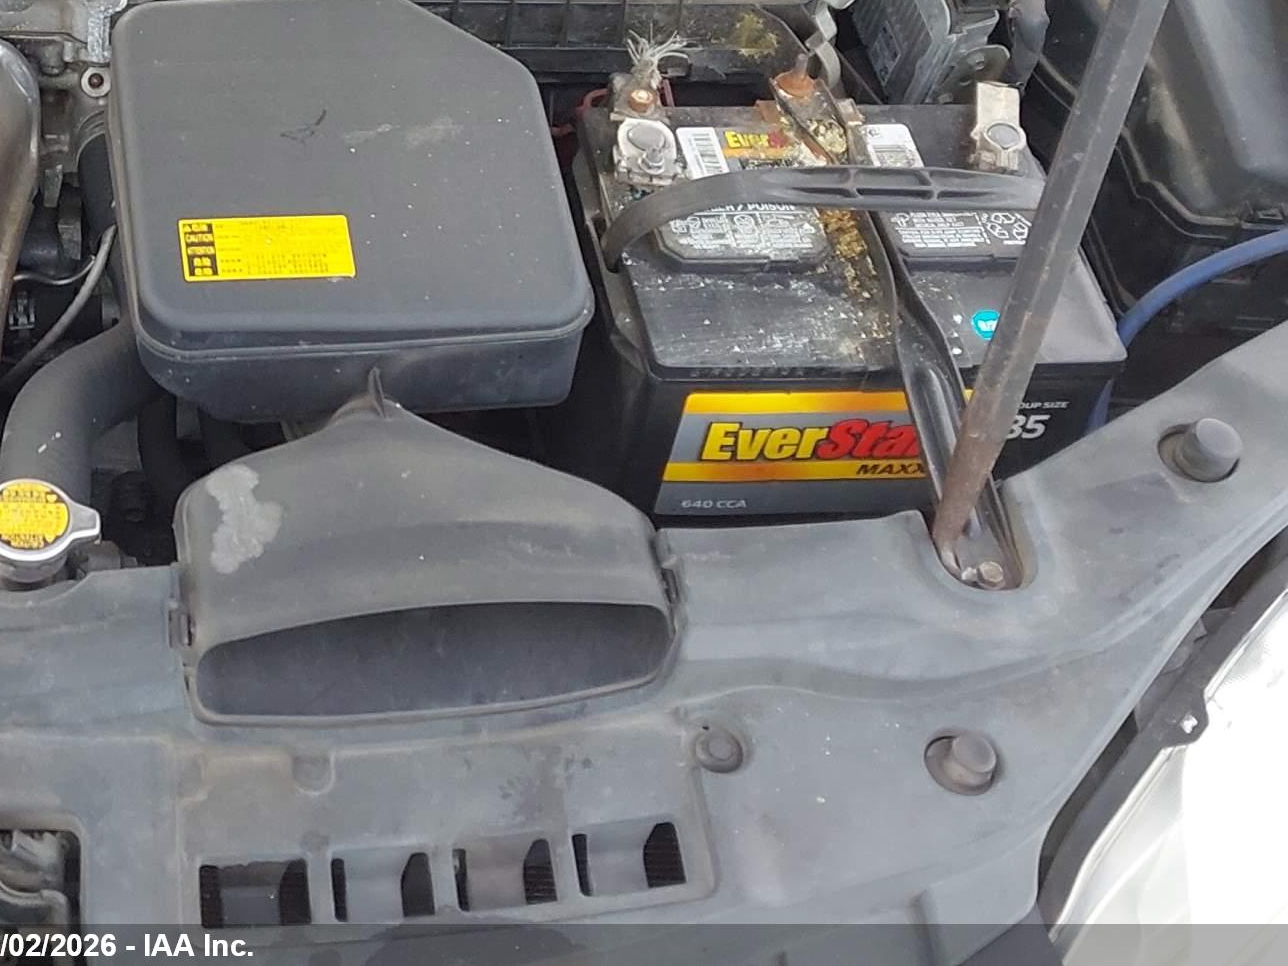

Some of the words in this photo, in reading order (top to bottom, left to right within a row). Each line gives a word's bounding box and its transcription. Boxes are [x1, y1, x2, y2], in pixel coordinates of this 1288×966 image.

[1042, 401, 1070, 409] SIZE
[700, 418, 922, 461] EverSta
[680, 499, 713, 509] 640
[716, 499, 748, 509] CCA
